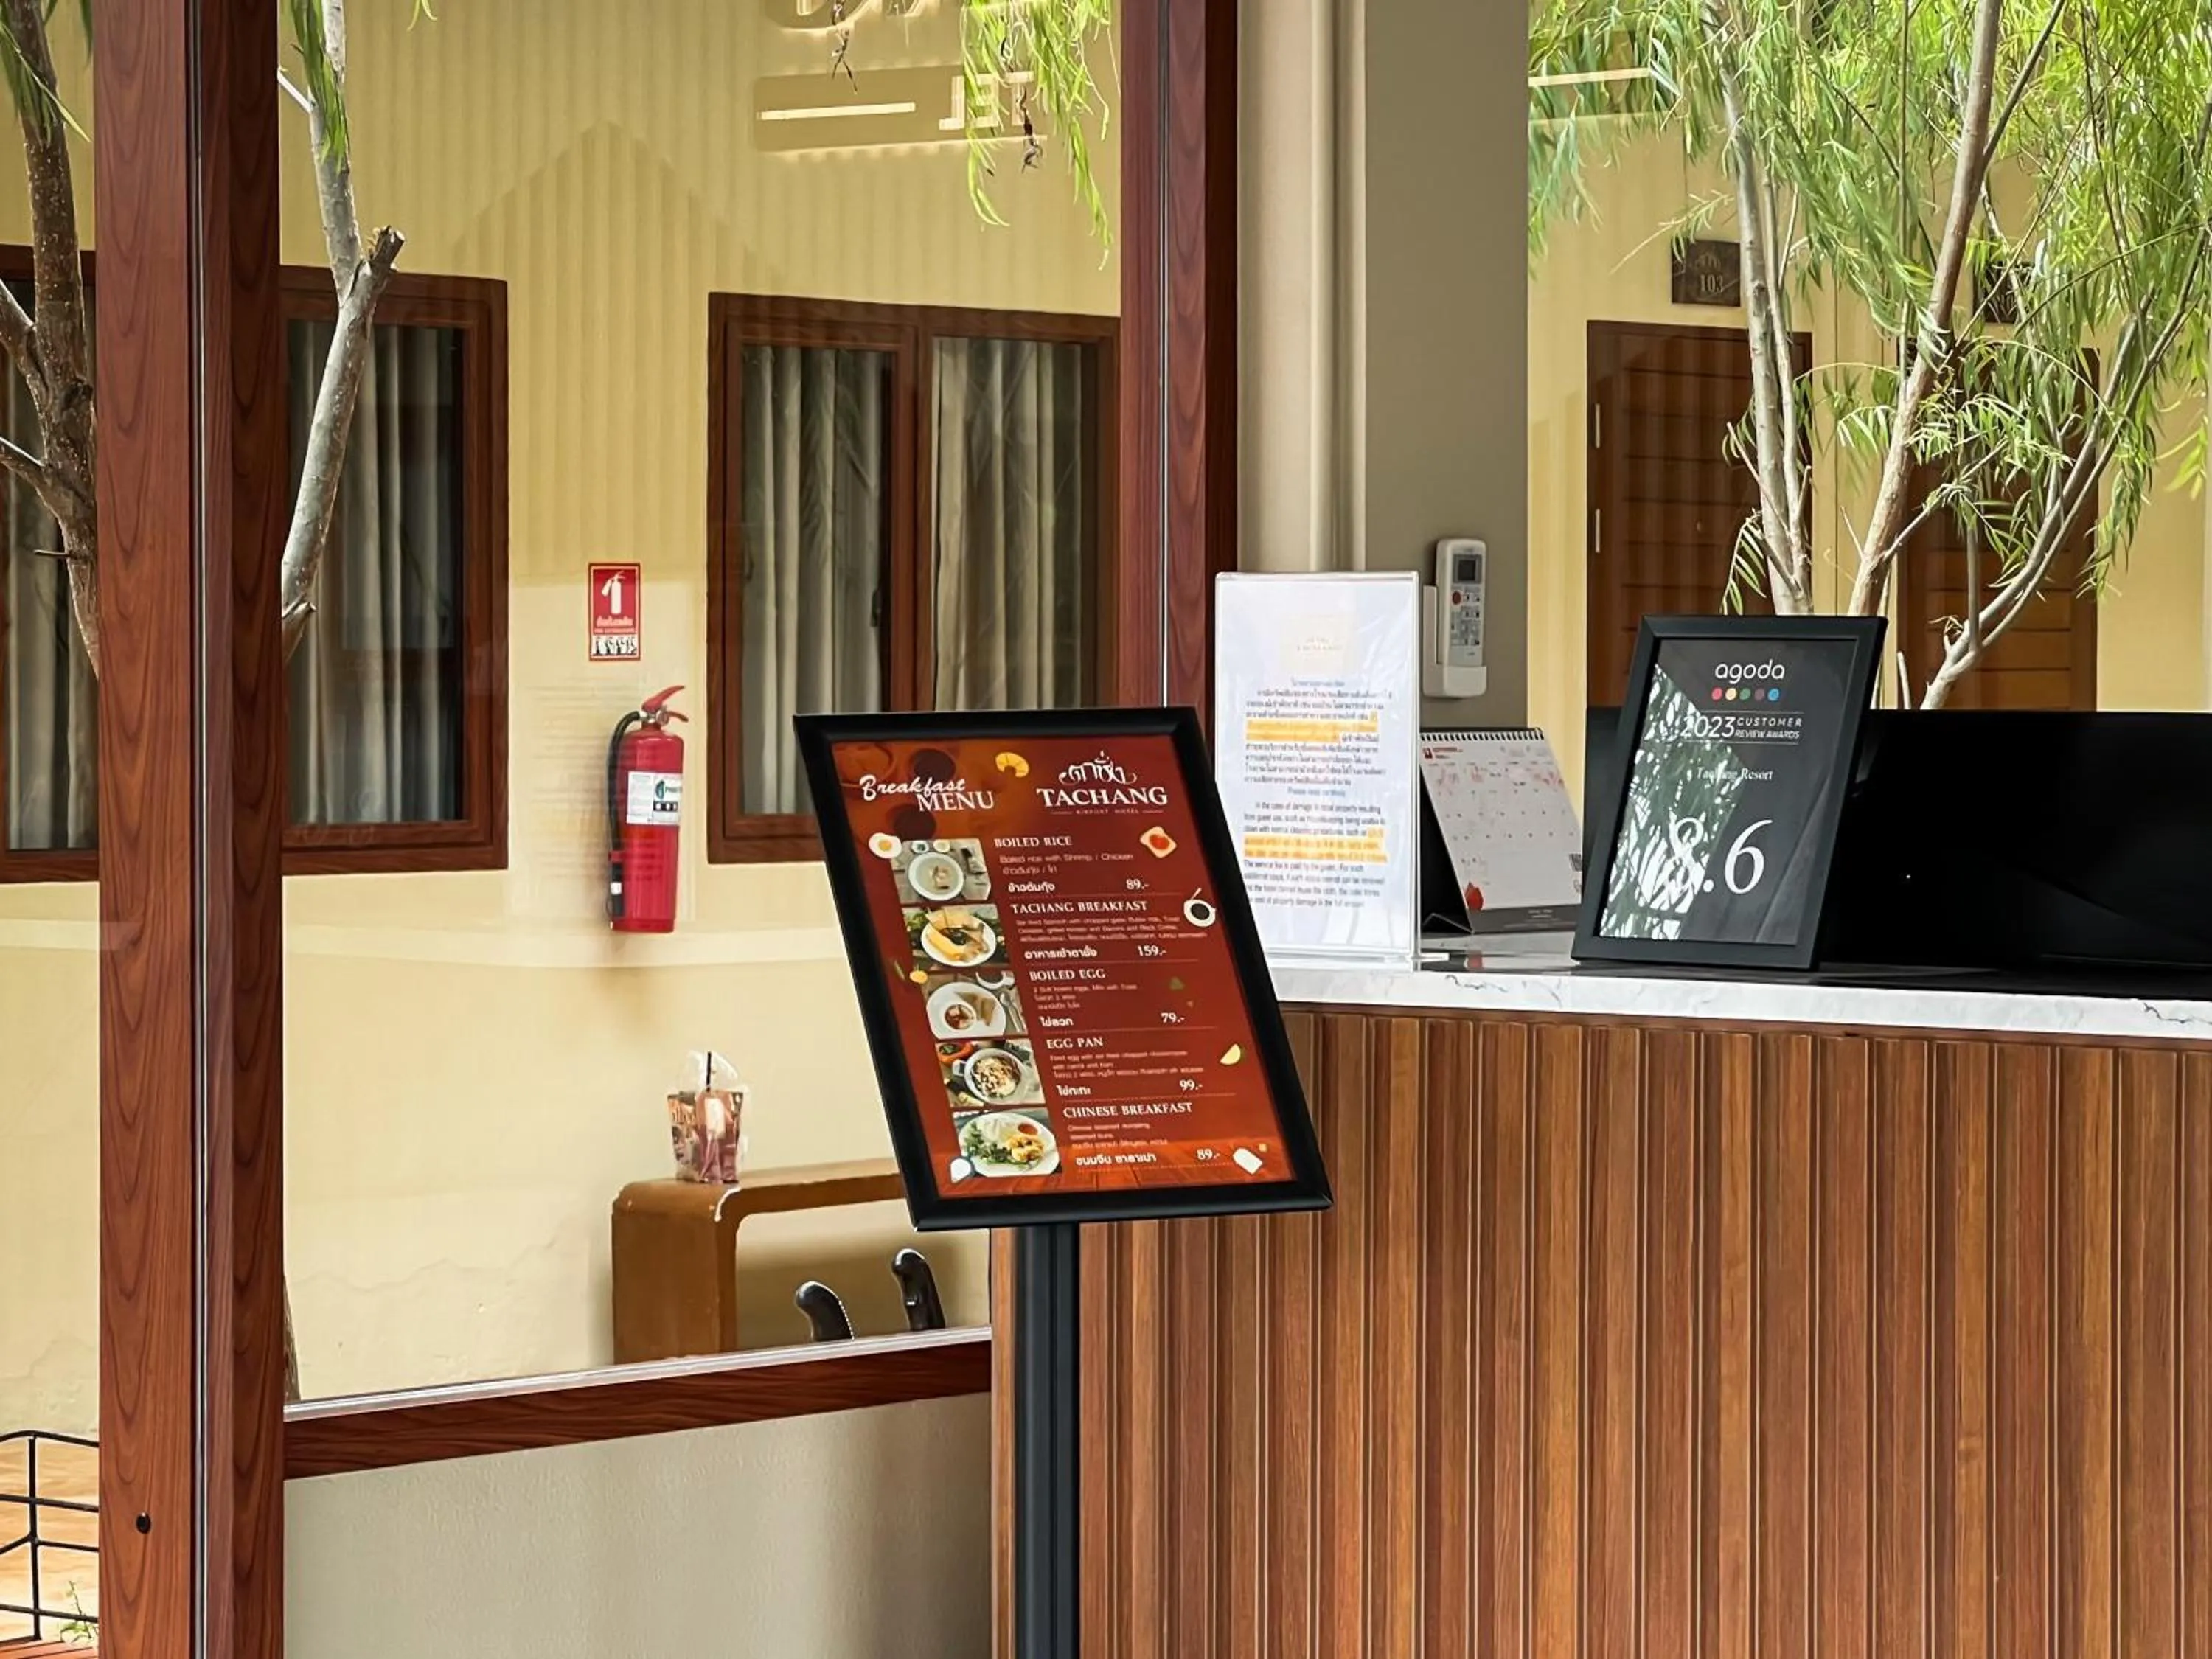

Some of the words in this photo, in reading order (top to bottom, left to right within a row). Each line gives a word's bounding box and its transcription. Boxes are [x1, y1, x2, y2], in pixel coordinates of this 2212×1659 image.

[1714, 659, 1786, 684] agoda
[1680, 715, 1736, 737] 2023
[1736, 717, 1802, 727] CUSTOMER
[1734, 729, 1764, 738] REVIEW
[1766, 730, 1800, 740] AWARDS
[1741, 768, 1773, 780] Resort
[859, 774, 966, 801] Breakfast
[916, 790, 994, 812] MENU
[1036, 786, 1168, 807] TACHANG
[994, 837, 1040, 848] BOILED
[1044, 836, 1072, 846] RICE
[1010, 902, 1074, 914] TACHANG
[1077, 900, 1148, 912] BREAKFAST
[1029, 970, 1075, 981] BOILED
[1079, 968, 1106, 979] EGG
[1046, 1038, 1074, 1049] EGG
[1077, 1036, 1104, 1048] PAN
[1062, 1105, 1119, 1119] CHINESE
[1121, 1102, 1192, 1116] BREAKFAST
